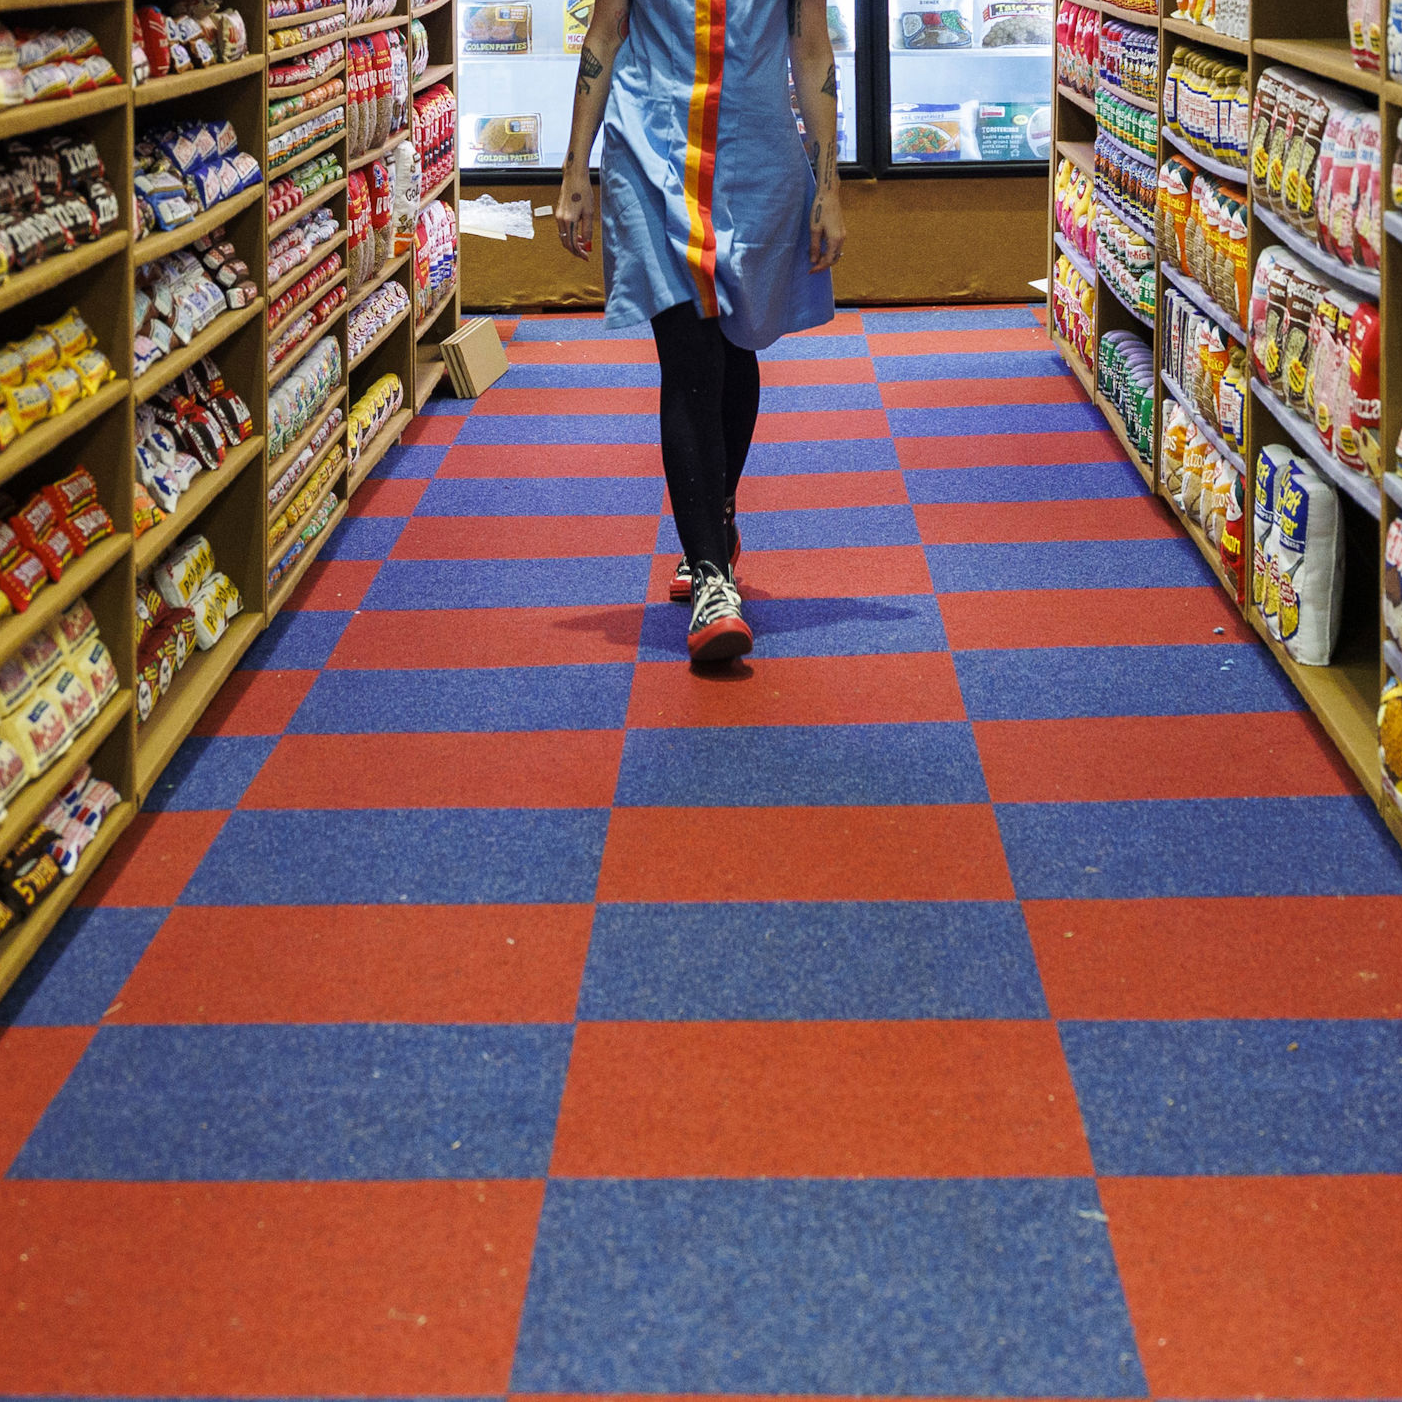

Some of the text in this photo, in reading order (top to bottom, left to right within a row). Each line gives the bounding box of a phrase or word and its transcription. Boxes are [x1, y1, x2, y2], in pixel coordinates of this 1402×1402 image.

[466, 42, 527, 52] GOLDEN PATTIES
[477, 153, 539, 163] GOLDEN PATTIES
